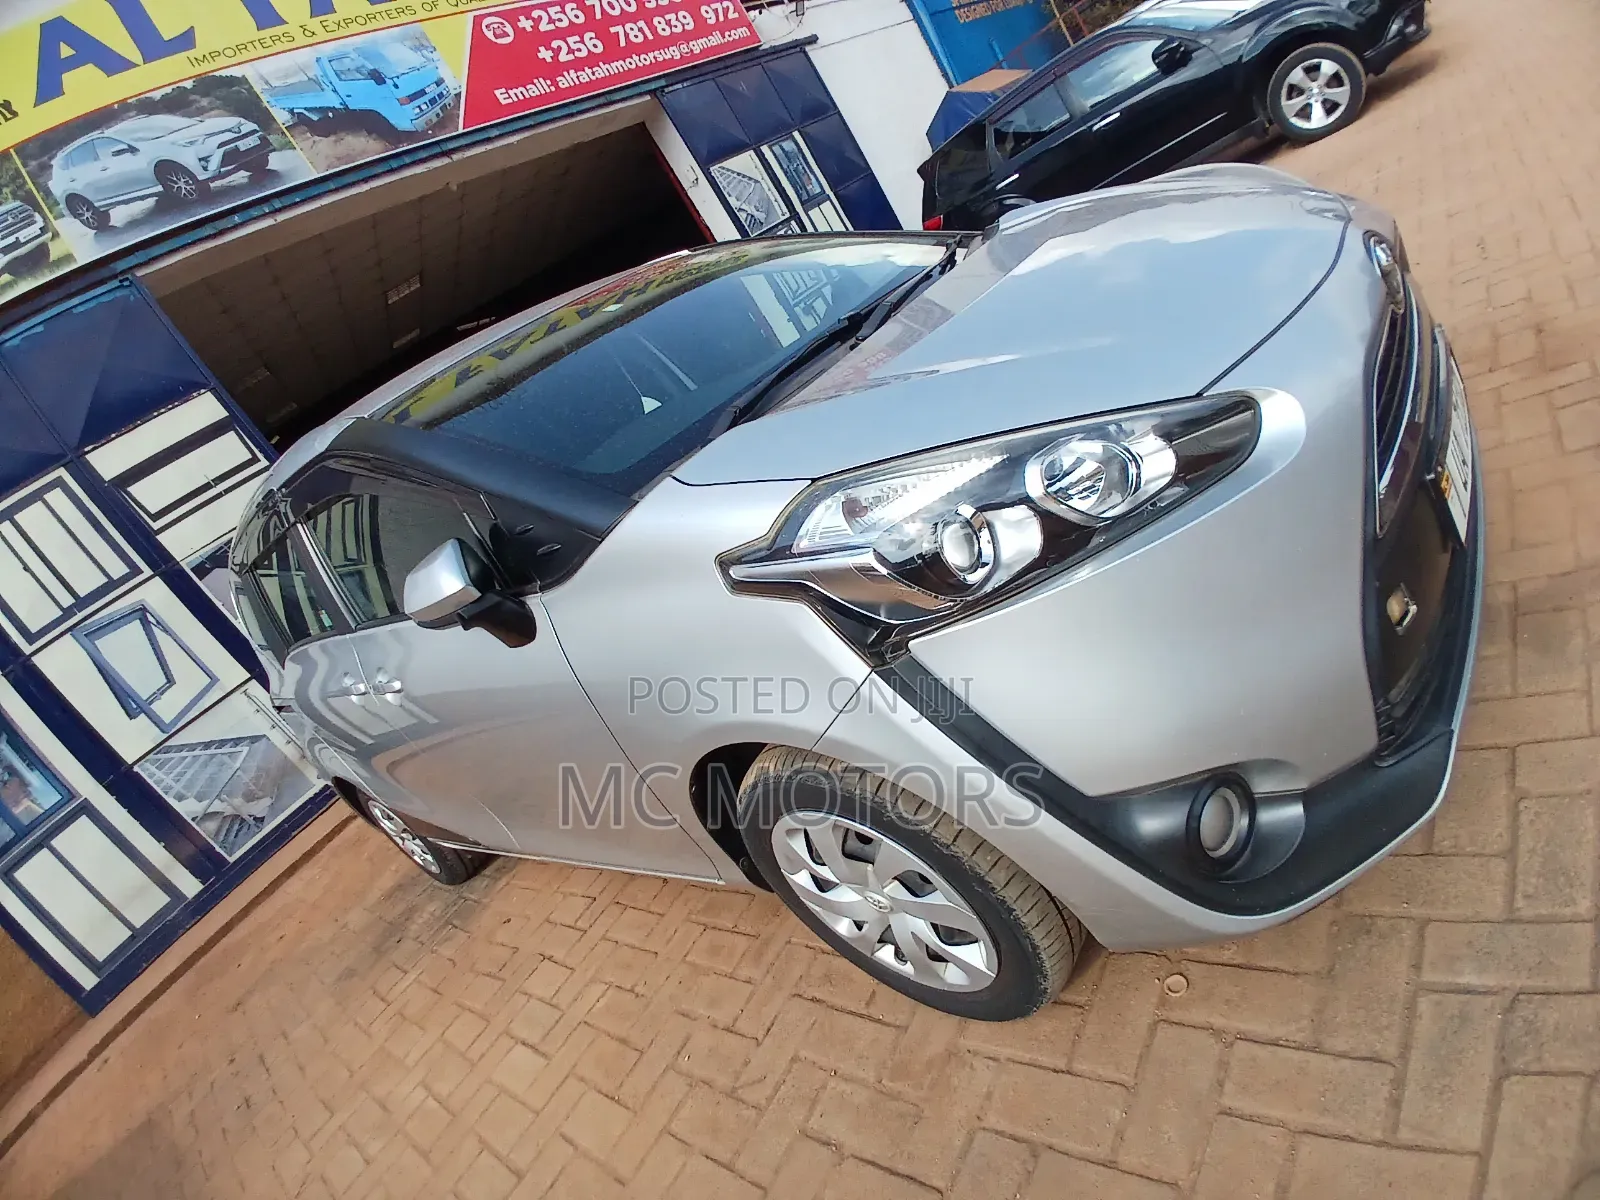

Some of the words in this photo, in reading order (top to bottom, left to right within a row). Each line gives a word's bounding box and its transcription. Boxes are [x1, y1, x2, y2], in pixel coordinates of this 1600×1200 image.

[299, 24, 317, 38] &
[421, 0, 439, 12] OF
[517, 2, 586, 32] +256
[537, 31, 604, 62] +256
[609, 20, 654, 47] 781
[652, 10, 695, 36] 839
[700, 0, 740, 24] 972
[493, 77, 556, 105] Email:
[556, 26, 750, 89] alfatahmotorsug@gmail.com
